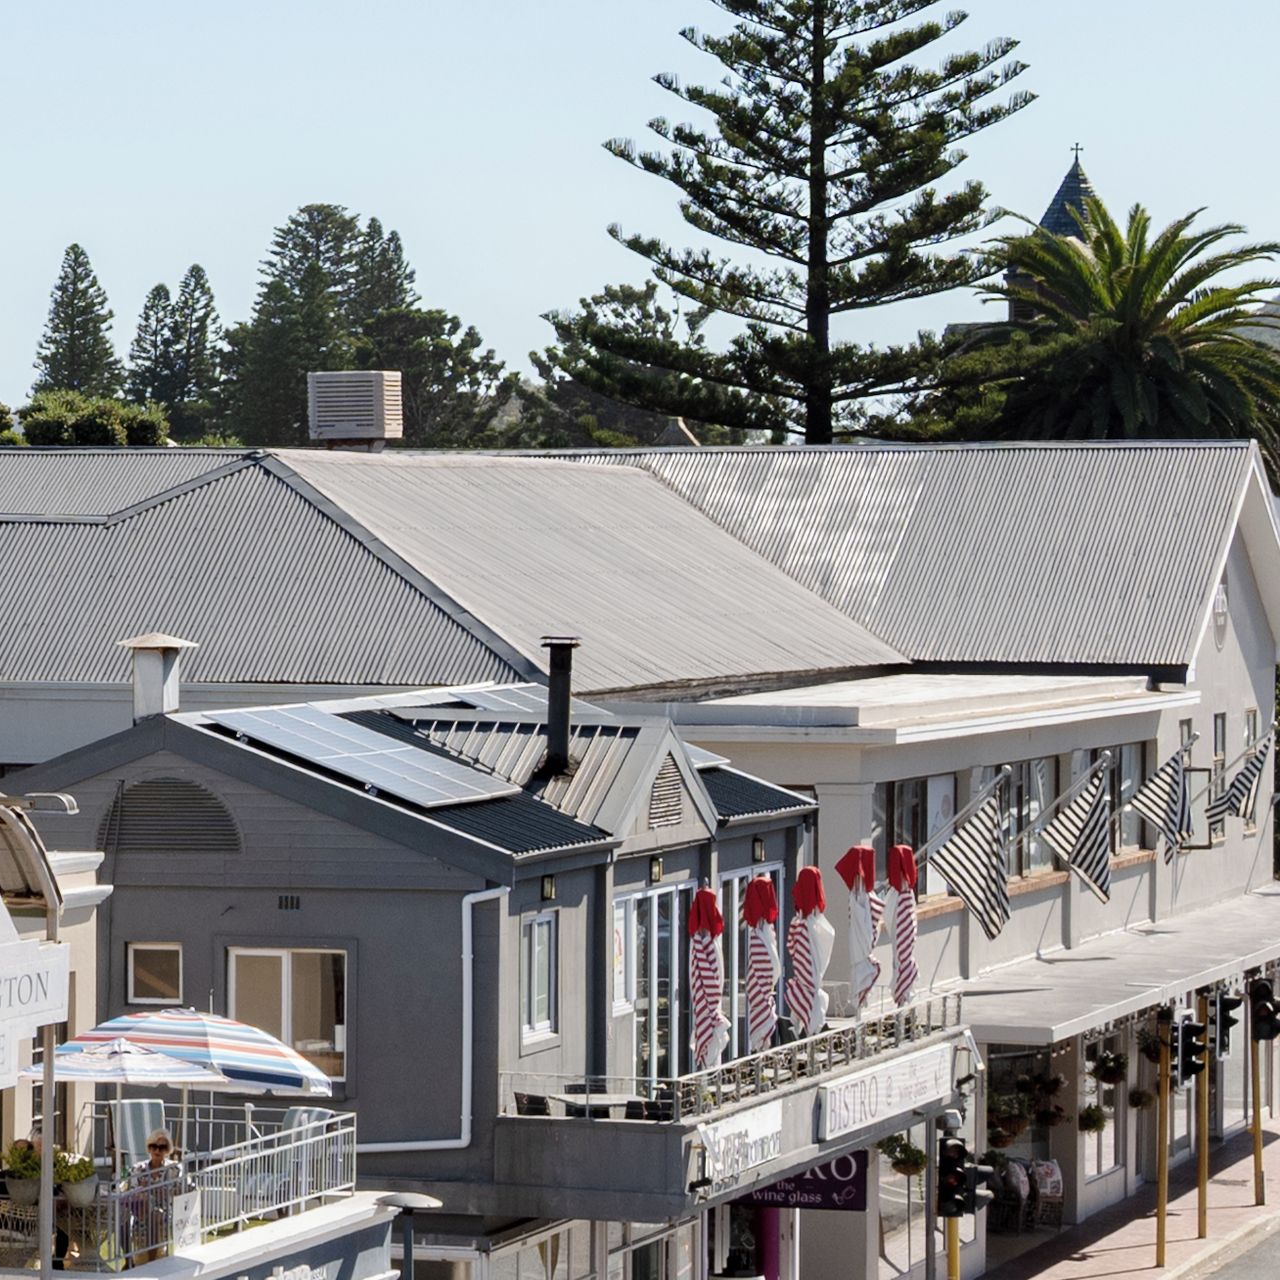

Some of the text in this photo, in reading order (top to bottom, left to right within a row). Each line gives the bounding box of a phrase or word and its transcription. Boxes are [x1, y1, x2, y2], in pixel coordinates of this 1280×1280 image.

[829, 1075, 879, 1134] BISTRO
[776, 1179, 795, 1191] the
[752, 1189, 822, 1205] wine glass
